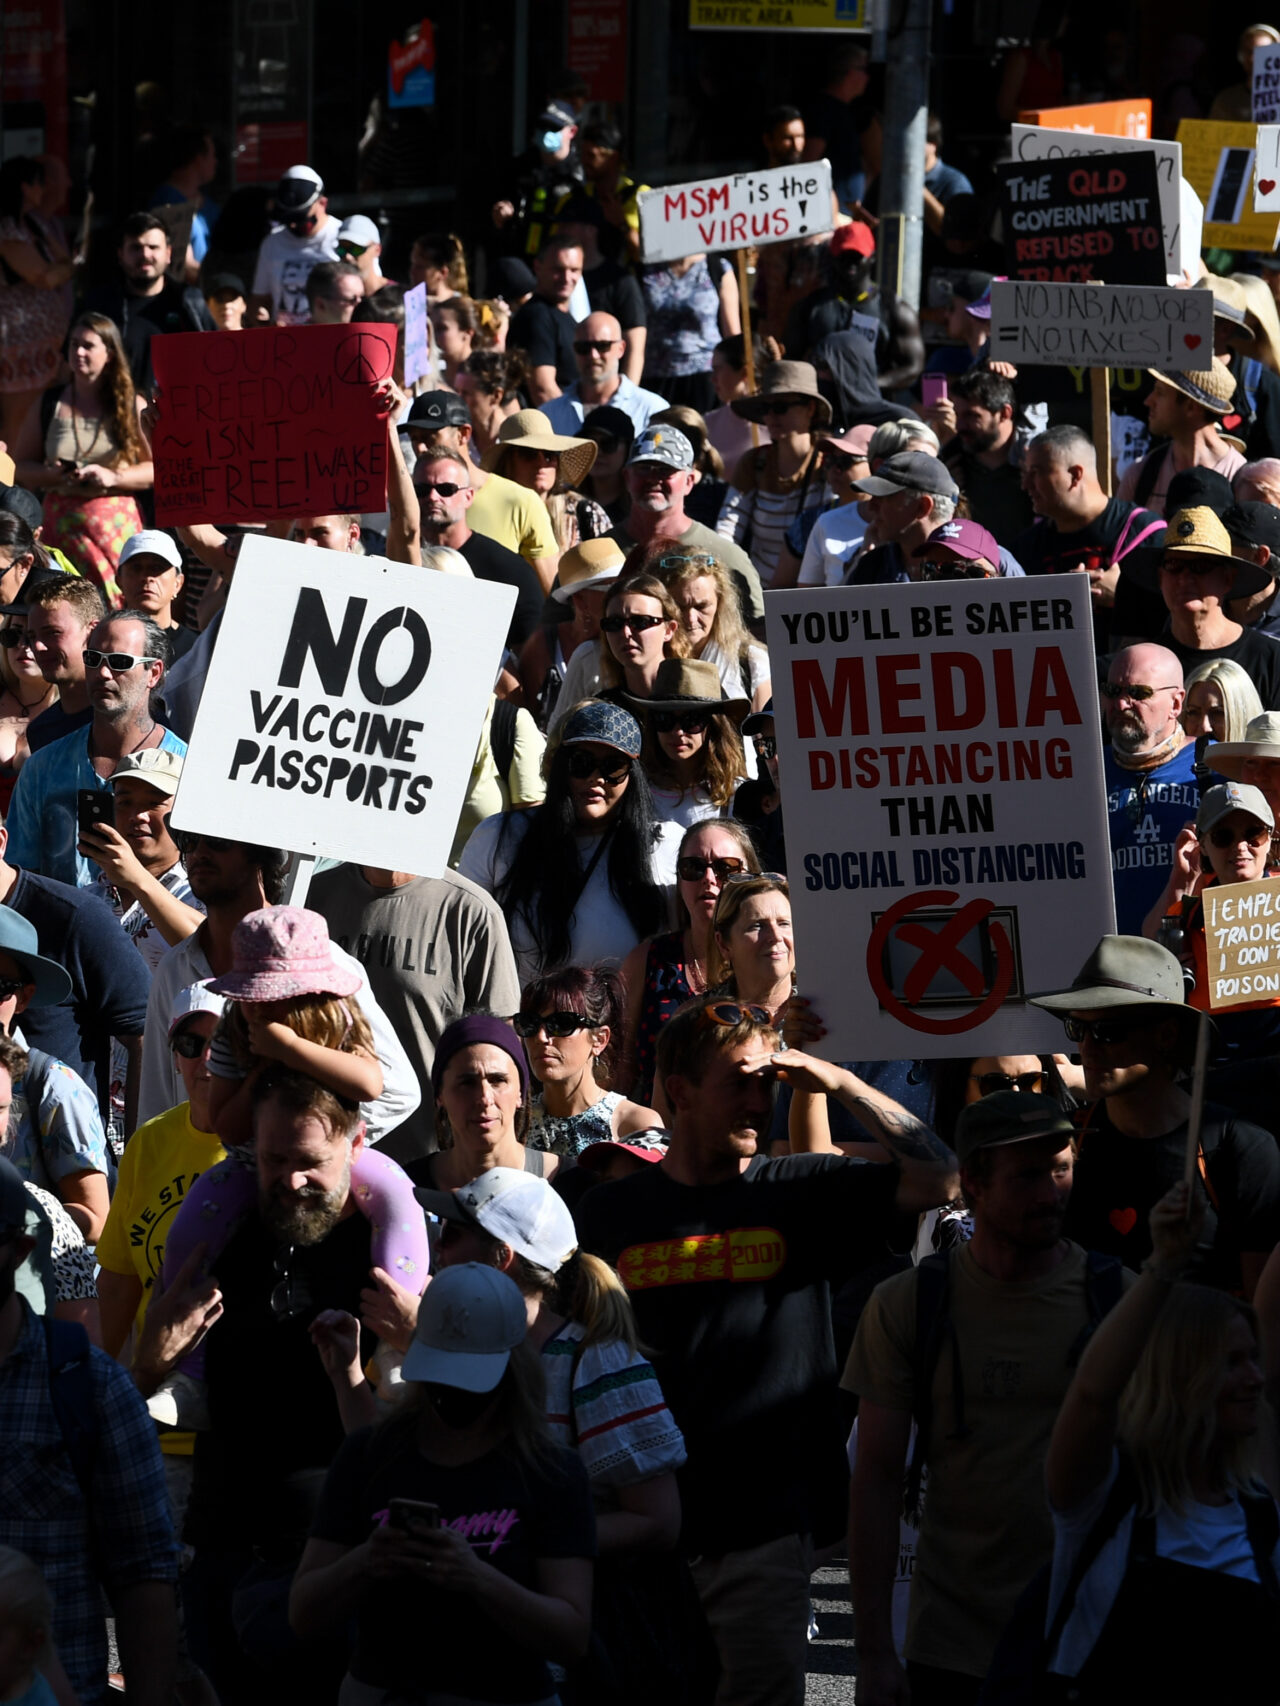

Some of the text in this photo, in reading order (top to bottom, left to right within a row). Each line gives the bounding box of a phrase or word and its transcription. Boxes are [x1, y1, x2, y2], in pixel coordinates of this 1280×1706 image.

[697, 6, 794, 25] TRAFFIC AREA
[664, 176, 818, 222] MSM is the
[1006, 168, 1128, 202] THE QLD
[1011, 197, 1150, 232] GOVERNMENT
[1015, 226, 1160, 262] REFUSED TO
[203, 332, 297, 376] OUR
[170, 374, 335, 422] FREEDOM
[201, 455, 311, 510] FREE!
[314, 442, 387, 479] WAKE
[331, 479, 370, 507] UP
[780, 598, 1075, 645] YOU'LL BE SAFER
[277, 586, 433, 706] NO
[791, 645, 1083, 740] MEDIA
[249, 688, 426, 764] VACCINE
[227, 738, 434, 816] PASSPORTS
[808, 737, 1074, 791] DISTANCING
[880, 792, 995, 838] THAN
[804, 839, 1086, 892] SOCIAL DISTANCING
[1220, 952, 1227, 972] I
[1215, 972, 1280, 1000] POISON
[130, 1206, 156, 1247] WE
